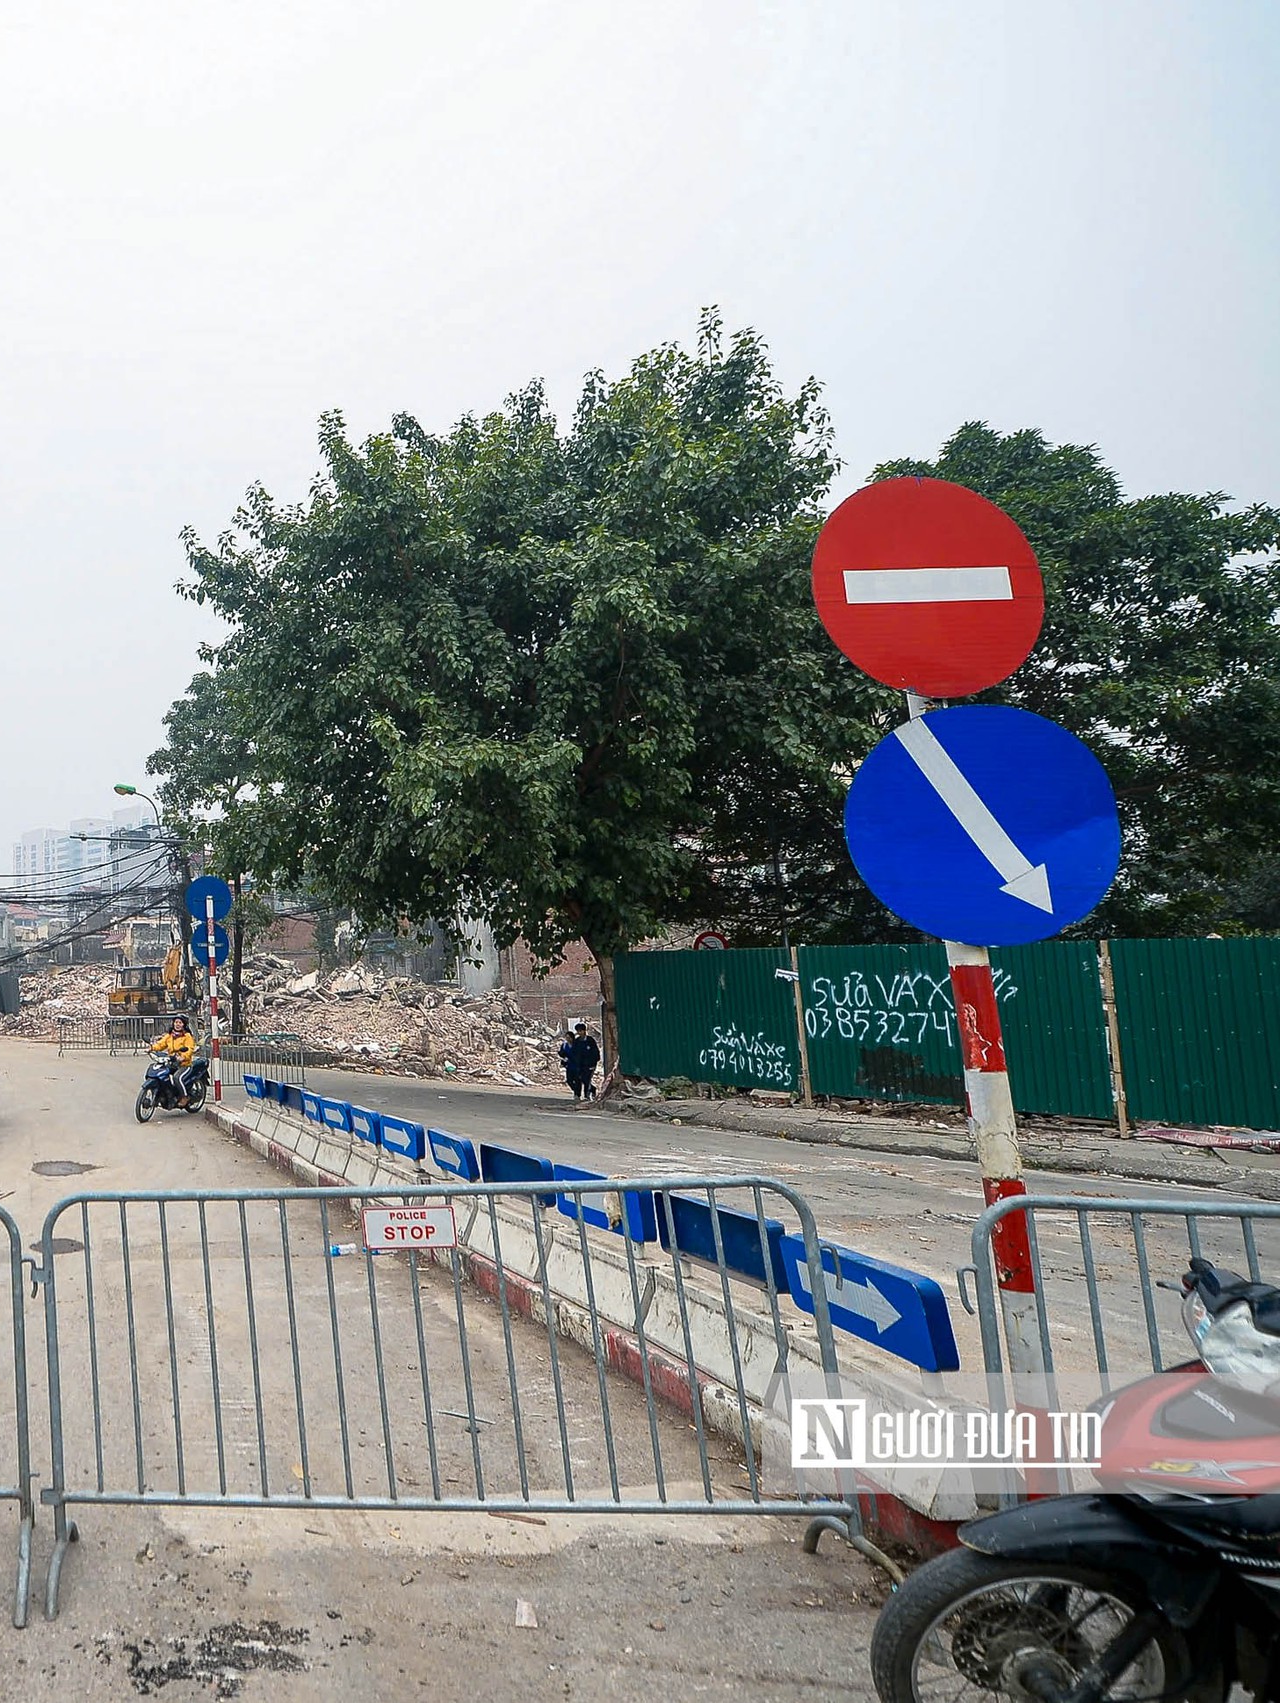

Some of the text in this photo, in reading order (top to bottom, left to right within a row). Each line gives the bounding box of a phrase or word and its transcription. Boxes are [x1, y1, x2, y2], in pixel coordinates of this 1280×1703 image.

[805, 1008, 957, 1047] 03853274
[389, 1211, 427, 1221] POLICE
[384, 1225, 436, 1241] STOP
